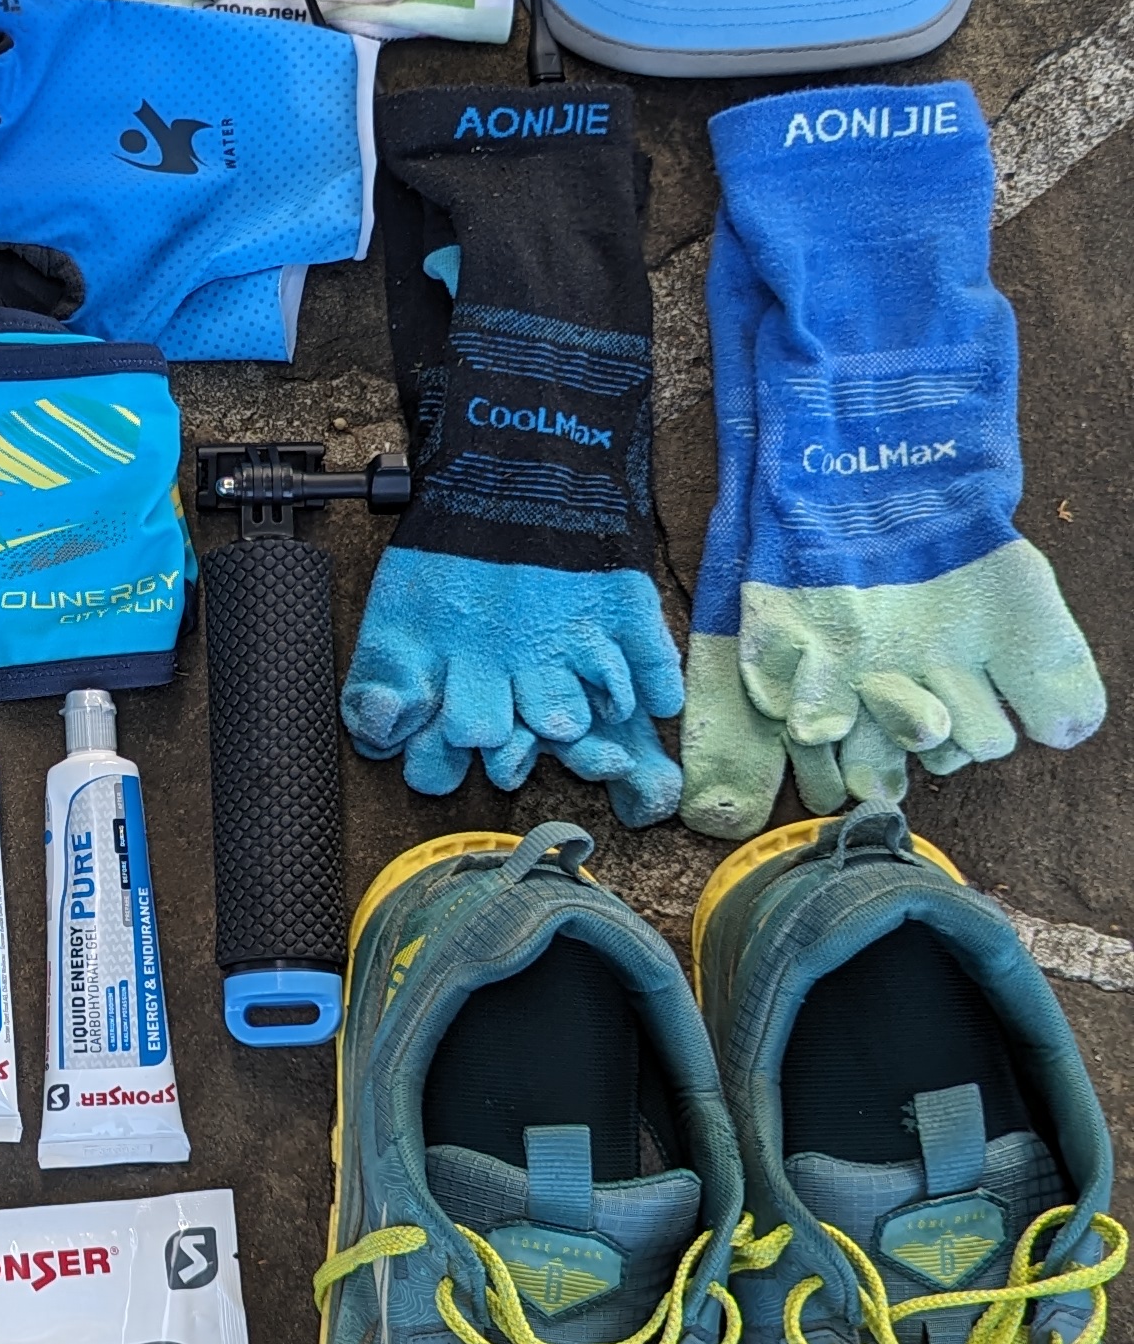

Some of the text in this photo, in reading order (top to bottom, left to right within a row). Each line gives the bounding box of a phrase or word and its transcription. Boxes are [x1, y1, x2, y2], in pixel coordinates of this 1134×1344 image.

[221, 116, 236, 170] WATER
[455, 104, 608, 139] AONIJIE
[784, 102, 959, 148] AONIJIE
[115, 598, 175, 616] RUN
[70, 832, 95, 1053] LIQUID ENERGY PURE
[85, 925, 101, 1053] CARBOHYDRATE GEL
[138, 887, 160, 1051] ENERGY & ENDURANCE
[81, 1083, 176, 1106] SPONSER
